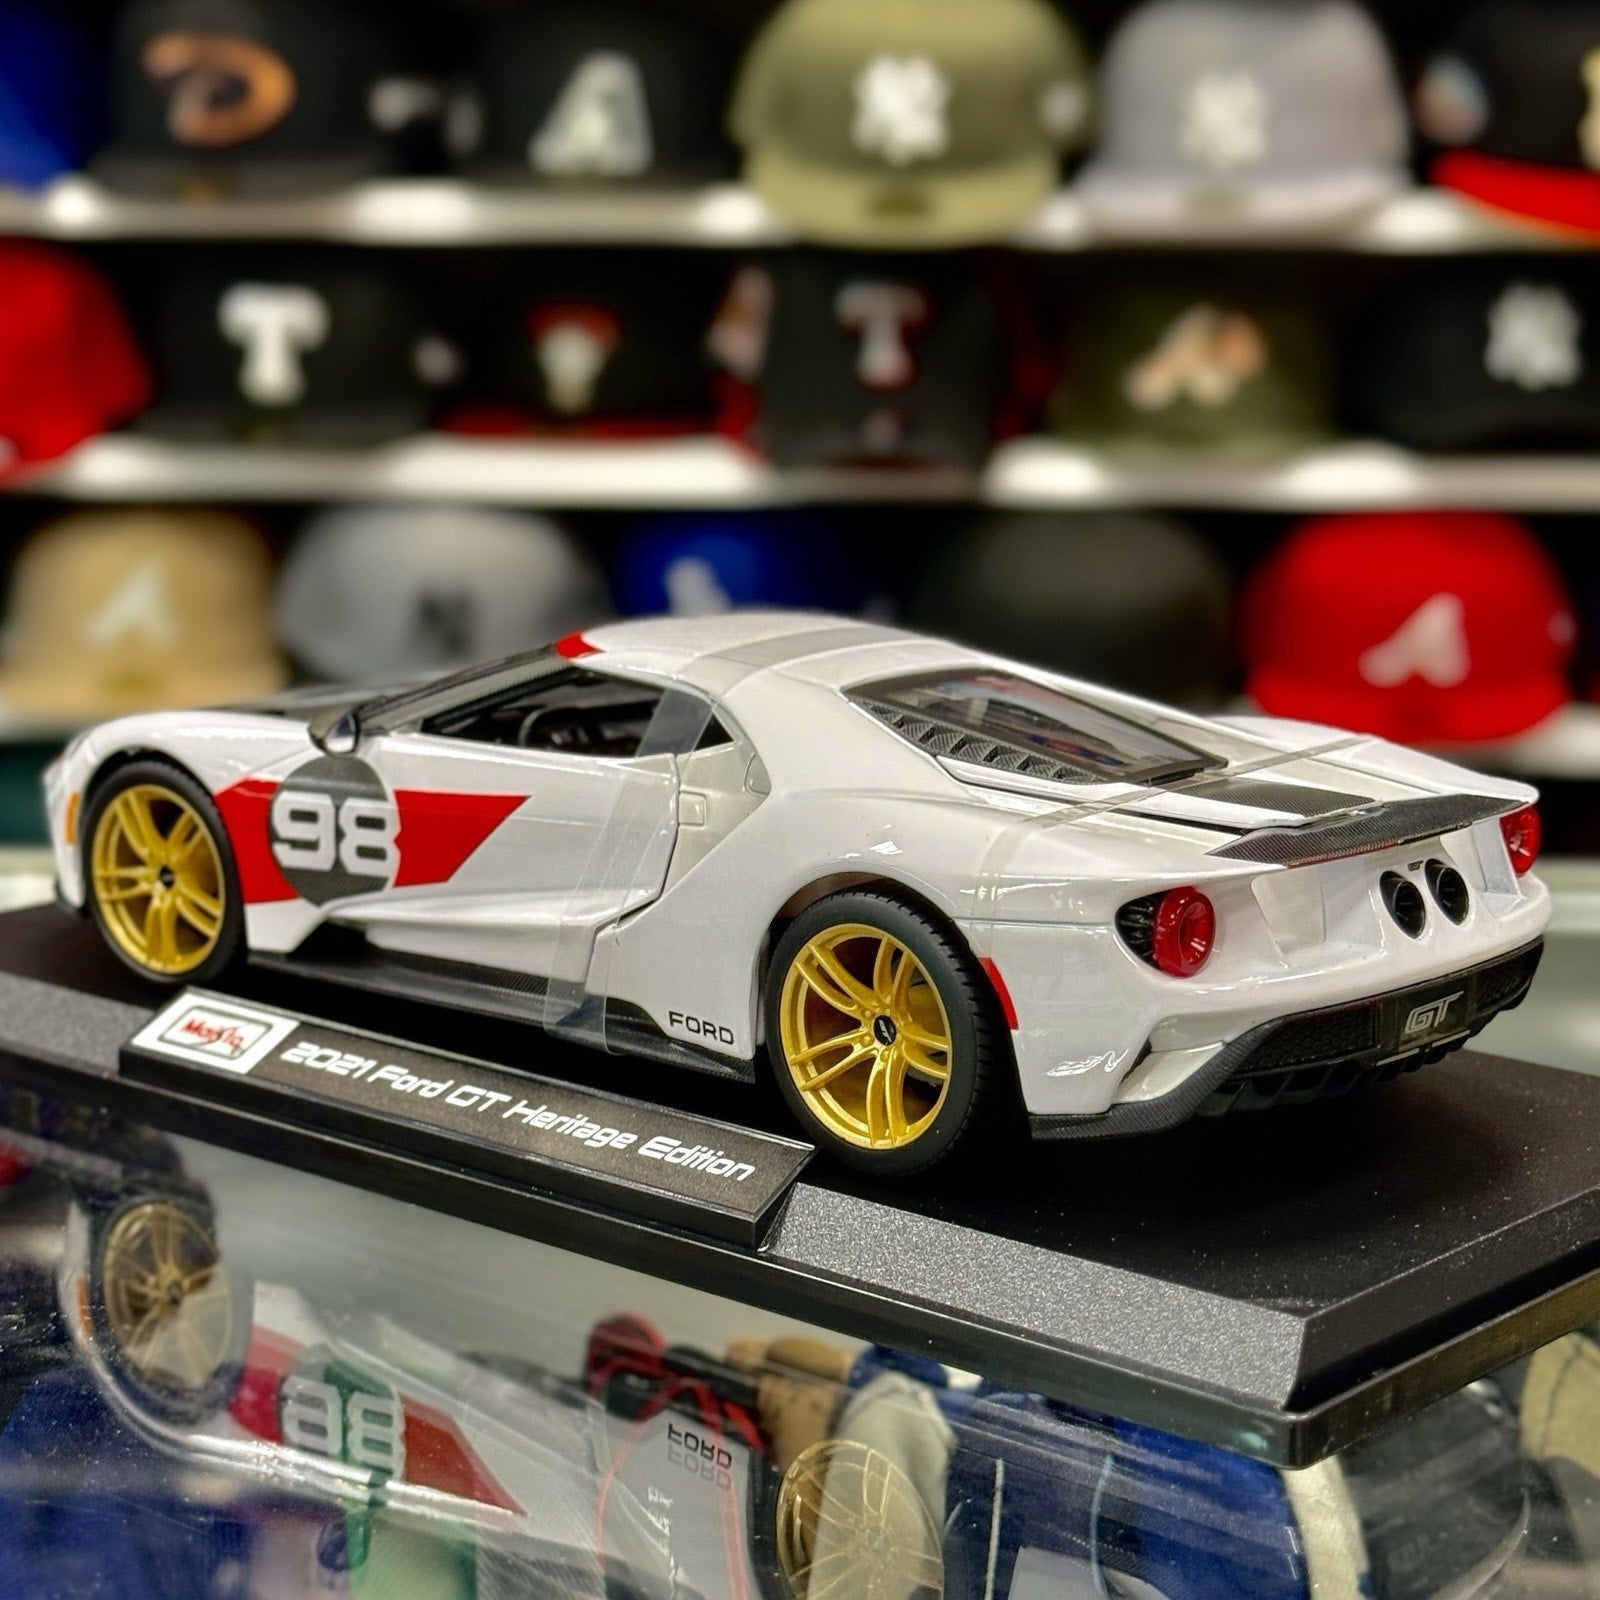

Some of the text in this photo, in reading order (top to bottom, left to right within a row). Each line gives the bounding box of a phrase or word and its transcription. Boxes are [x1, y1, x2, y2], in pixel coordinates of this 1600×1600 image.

[271, 790, 401, 878] 98
[668, 1010, 734, 1046] FORD
[1404, 990, 1464, 1034] GT
[280, 1041, 756, 1182] 2021 Ford GT Heritage Edition
